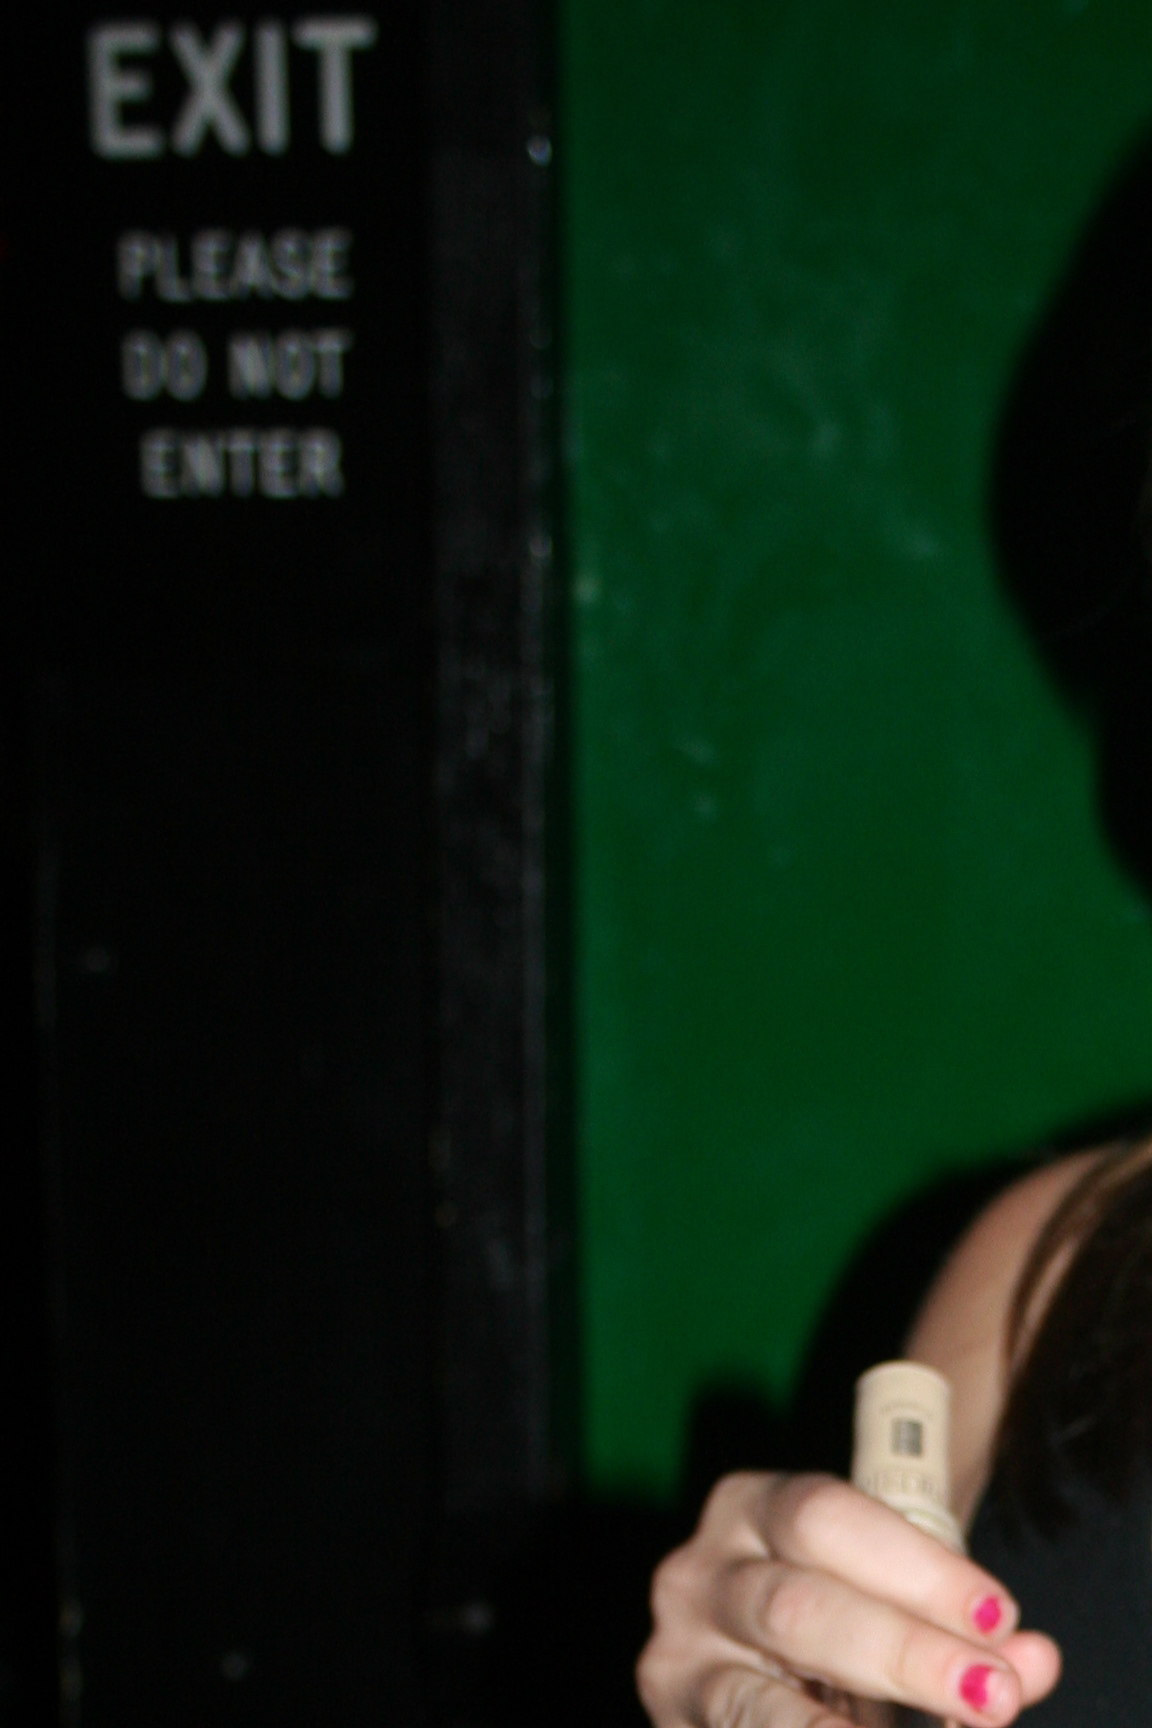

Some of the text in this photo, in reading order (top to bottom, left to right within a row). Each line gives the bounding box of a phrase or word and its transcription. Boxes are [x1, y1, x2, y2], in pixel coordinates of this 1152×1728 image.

[88, 17, 378, 158] EXIT
[117, 229, 354, 301] PLEASE
[122, 328, 353, 400] DO NOT
[139, 426, 345, 498] ENTER
